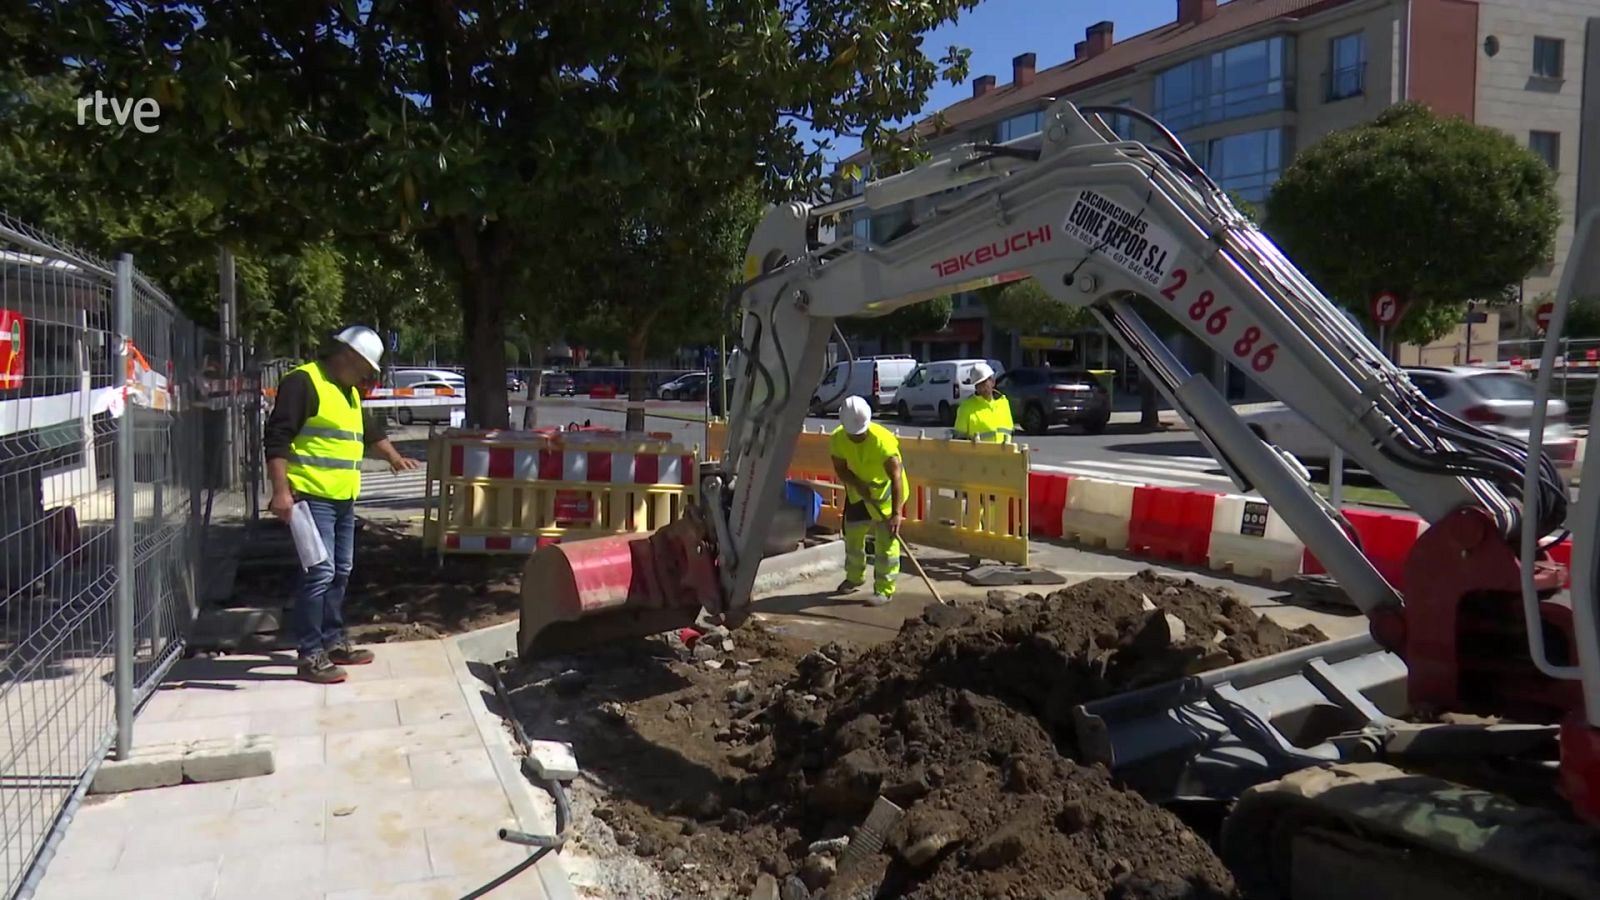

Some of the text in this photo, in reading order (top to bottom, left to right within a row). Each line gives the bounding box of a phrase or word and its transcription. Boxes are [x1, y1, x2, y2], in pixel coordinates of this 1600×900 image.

[1069, 200, 1167, 276] EUME REPOR S.L.
[1080, 190, 1149, 235] EXCAVACIONES
[930, 224, 1051, 278] TAKEUCHI
[1160, 268, 1279, 373] 2 86 86
